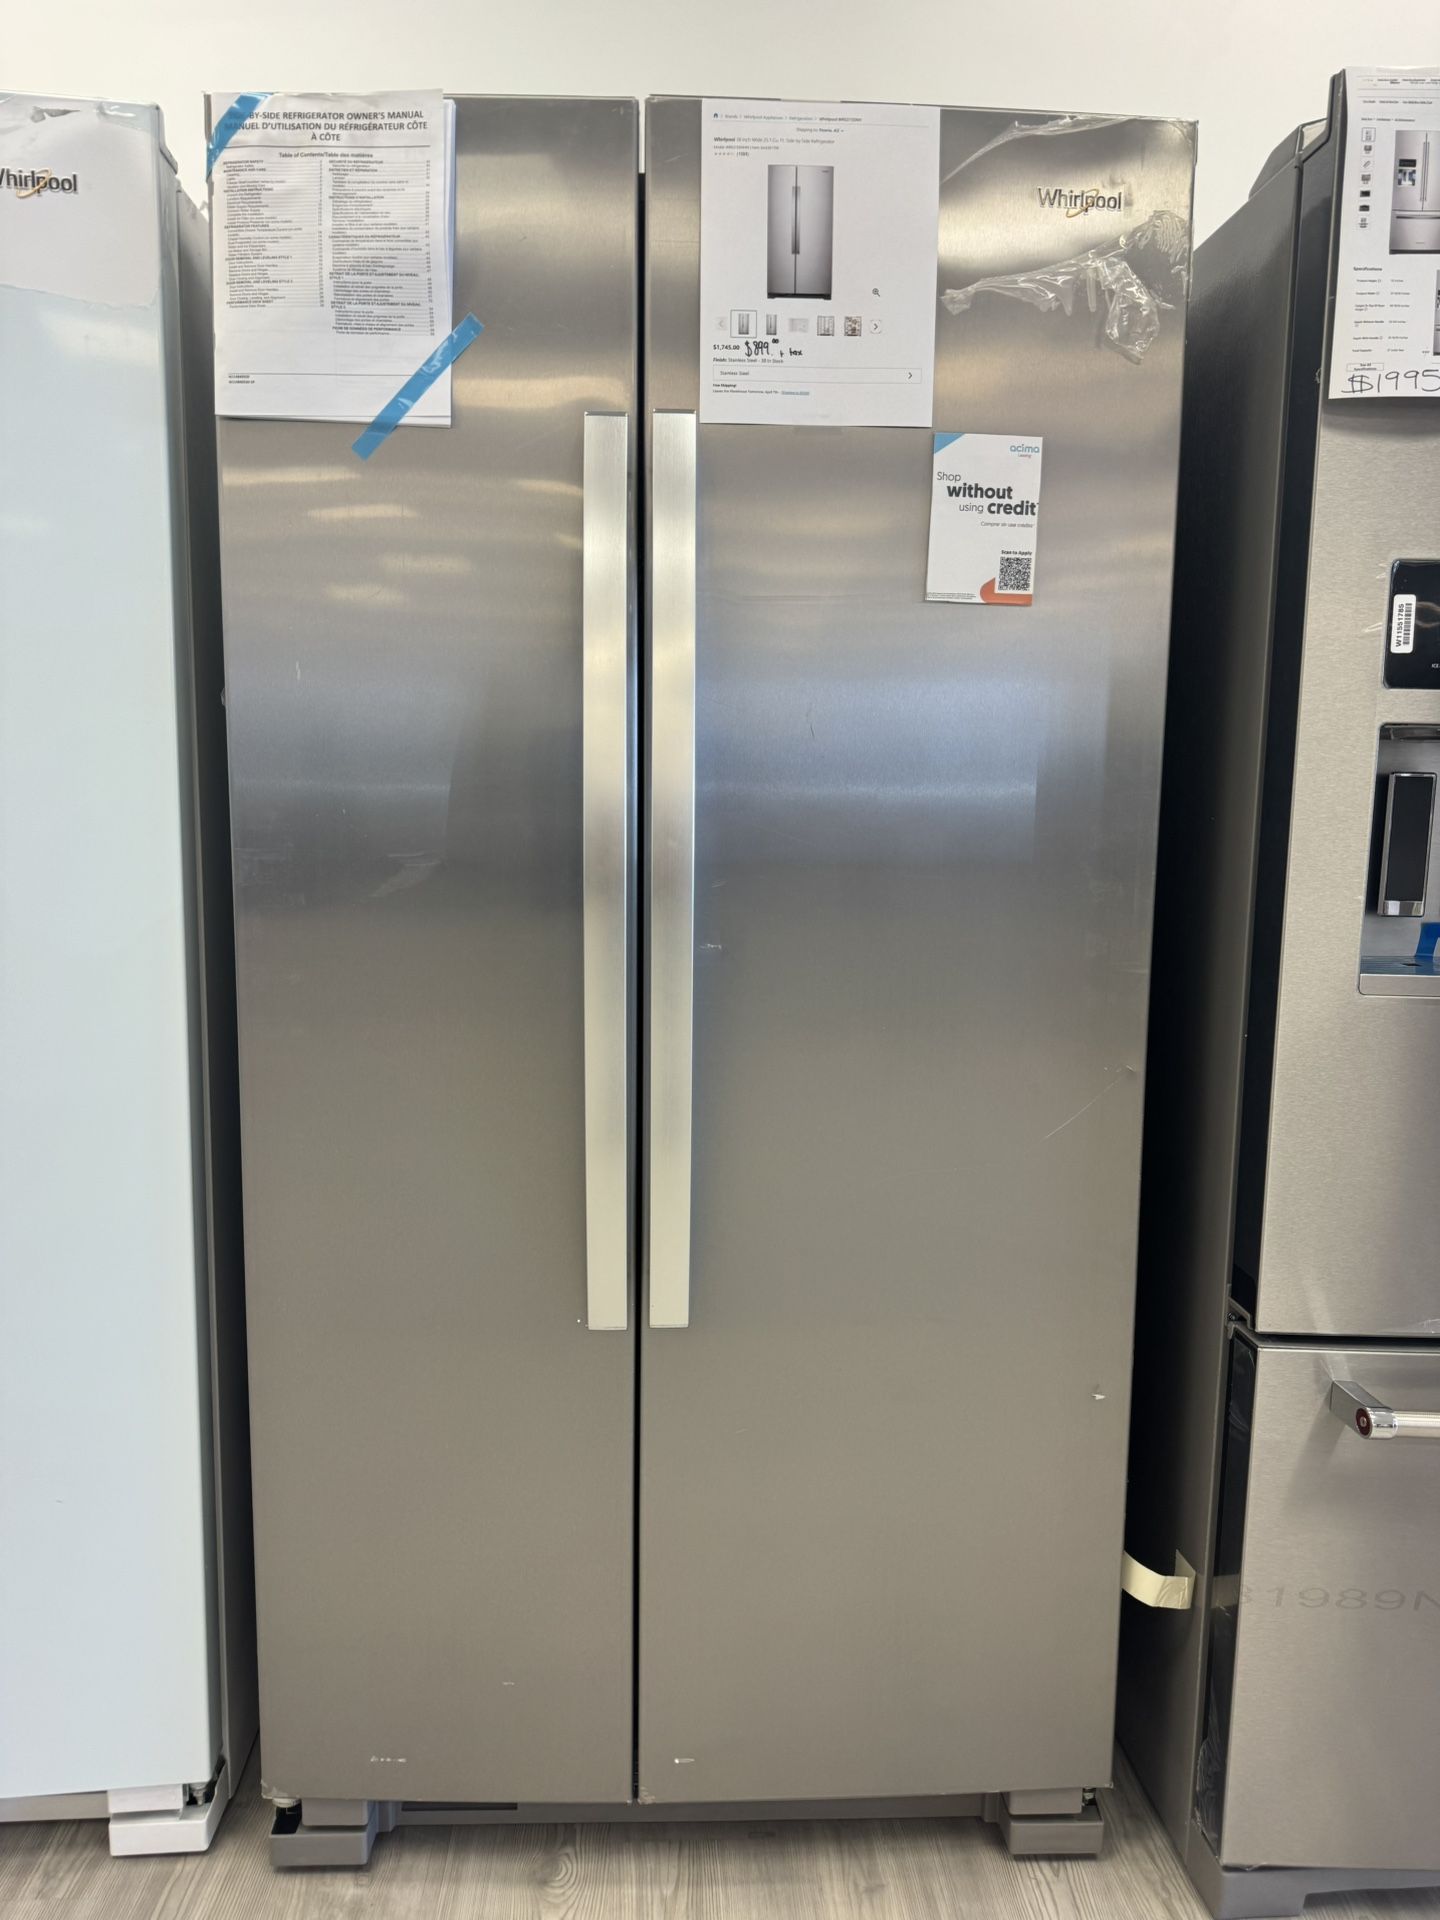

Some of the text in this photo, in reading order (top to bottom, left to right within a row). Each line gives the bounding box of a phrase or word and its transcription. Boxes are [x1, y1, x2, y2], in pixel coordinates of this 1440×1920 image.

[282, 111, 345, 120] REFRIGERATOR
[347, 111, 385, 120] OWNER'S
[387, 110, 424, 119] MANUAL
[324, 122, 336, 130] DU
[338, 121, 405, 131] RÉFRIGÉRATEUR
[407, 120, 428, 130] CÔTE
[311, 132, 341, 141] À CÔTE
[0, 168, 77, 196] hirlpool
[1038, 187, 1122, 214] Whirlpool
[789, 347, 803, 356] tax
[1341, 369, 1440, 394] $1995
[1009, 444, 1040, 454] acima
[936, 471, 962, 483] Shop
[946, 482, 1013, 500] without
[959, 503, 984, 515] using
